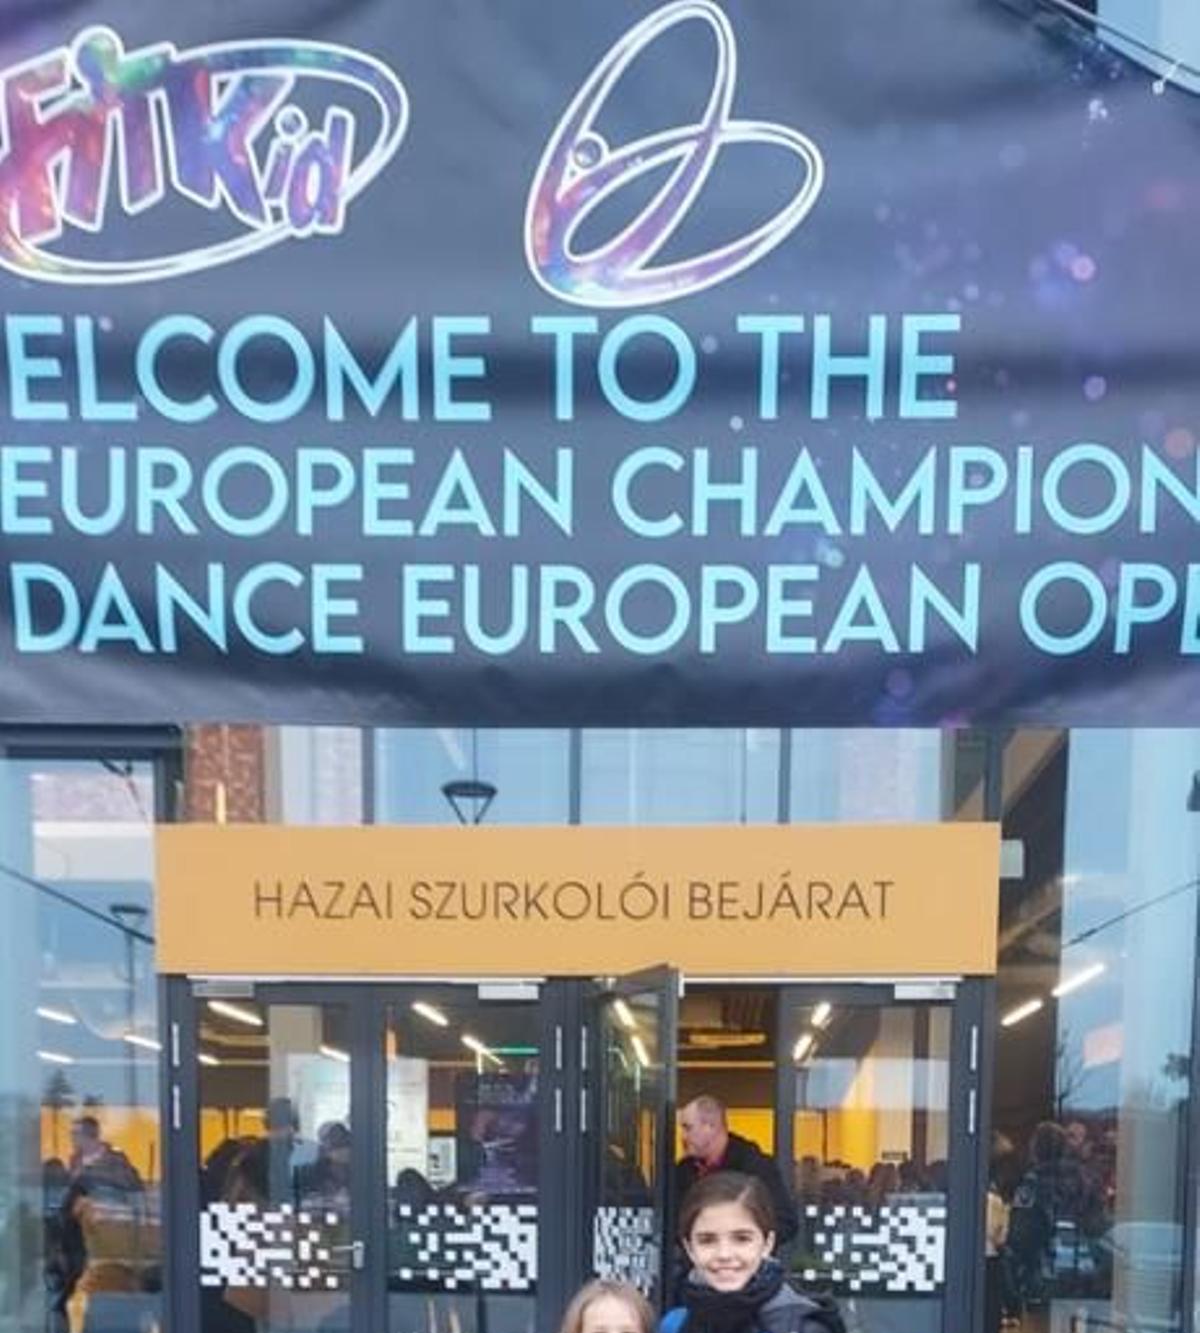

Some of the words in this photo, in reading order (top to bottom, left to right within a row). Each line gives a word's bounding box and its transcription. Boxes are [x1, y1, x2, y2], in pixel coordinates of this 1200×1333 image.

[531, 314, 696, 422] TO
[736, 314, 961, 420] THE
[0, 446, 574, 537] EUROPEAN
[612, 444, 1200, 537] CHAMPION
[10, 562, 364, 653] DANCE
[403, 562, 981, 654] EUROPEAN
[253, 881, 394, 920] HAZAI
[408, 870, 671, 921] SZURKOLÓI
[687, 870, 895, 920] BEJÁRAT
